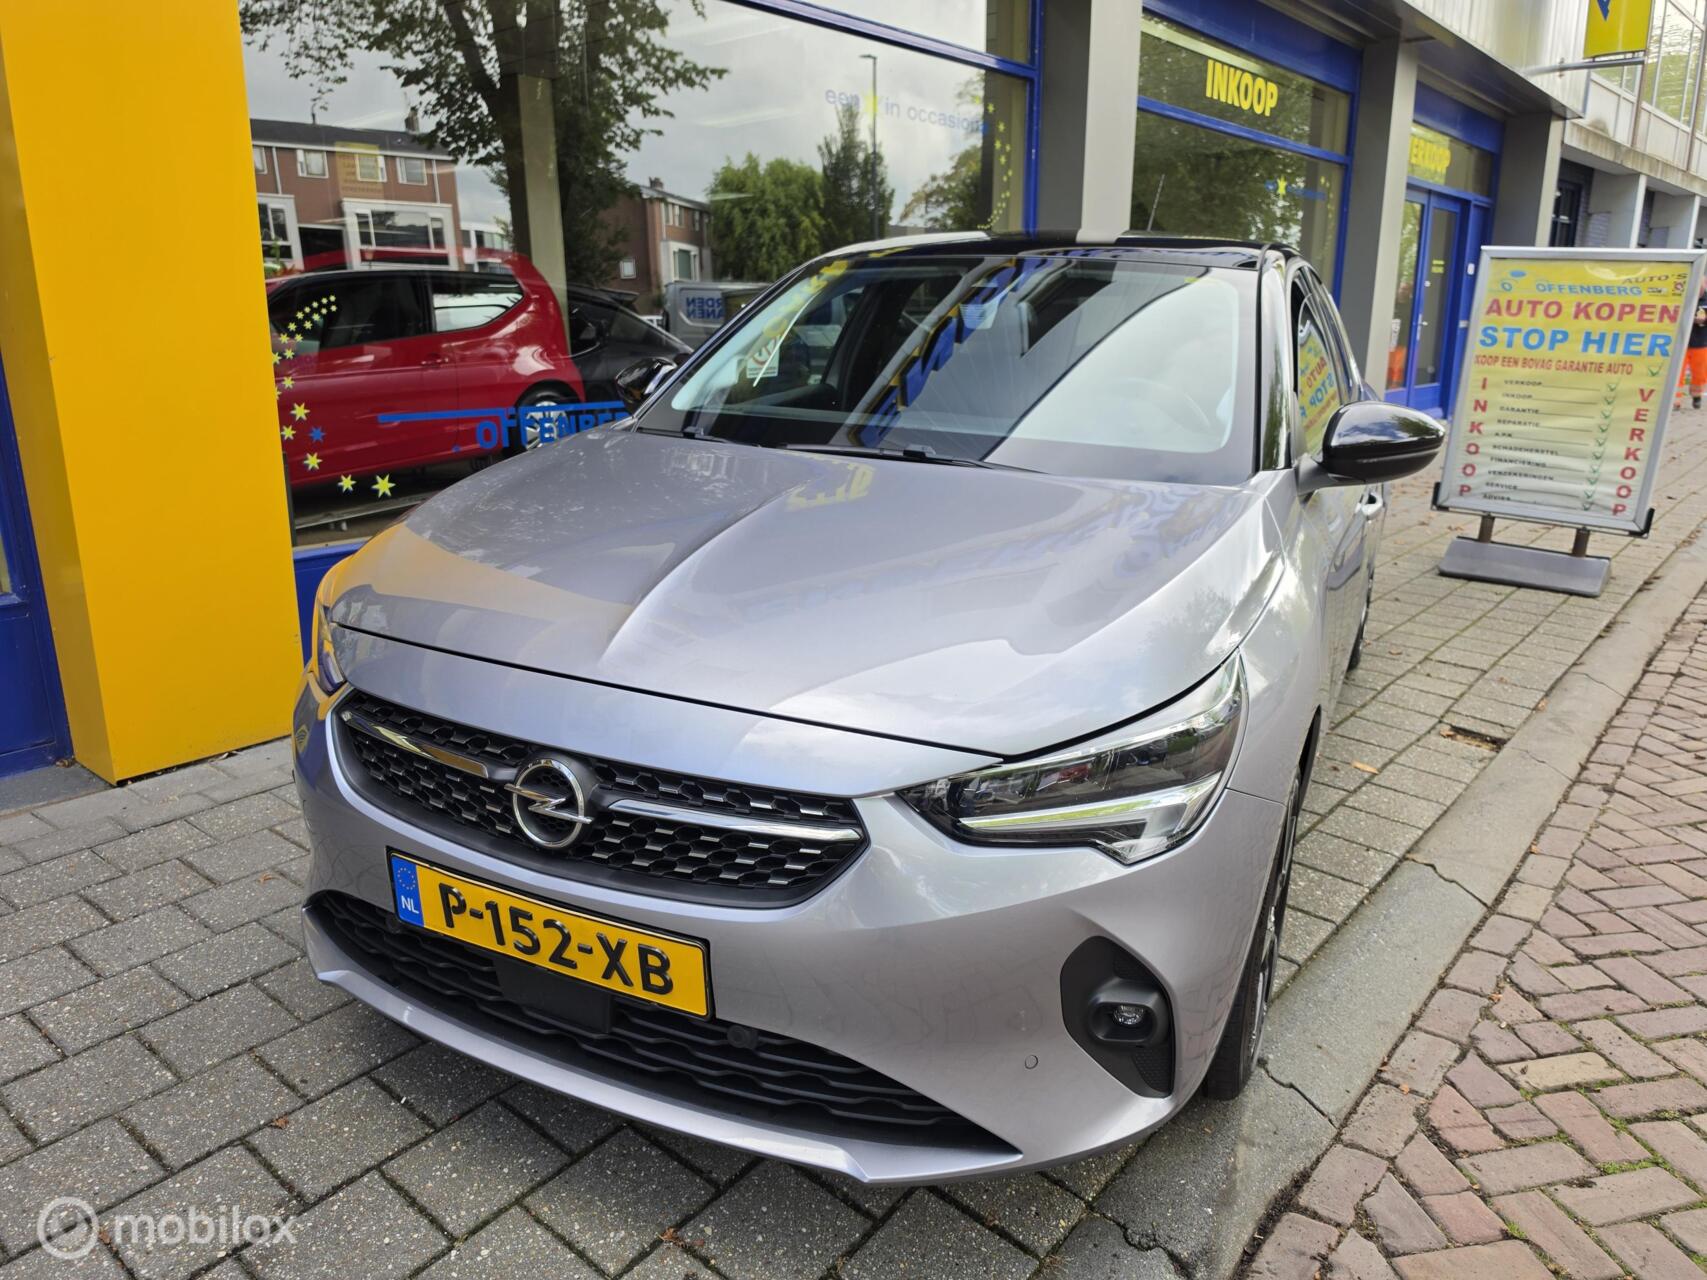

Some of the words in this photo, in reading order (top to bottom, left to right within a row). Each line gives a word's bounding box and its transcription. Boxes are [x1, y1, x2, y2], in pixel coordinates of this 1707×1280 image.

[1205, 58, 1279, 117] INKOOP
[885, 97, 900, 118] in
[1410, 135, 1452, 174] ERKOOP
[1536, 282, 1643, 296] OFFENBERG
[1485, 298, 1563, 320] AUTO
[1572, 301, 1680, 324] KOPEN
[1479, 326, 1569, 351] STOP
[1581, 331, 1673, 357] HIER
[1501, 356, 1519, 368] EEN
[1521, 358, 1552, 370] BOVAG
[1555, 360, 1604, 374] GARANTIE
[1606, 363, 1633, 376] AUTO
[1458, 377, 1488, 497] INKOOP
[1612, 388, 1656, 516] VERKOOP
[401, 895, 419, 914] NL
[438, 882, 674, 995] P-152-XB
